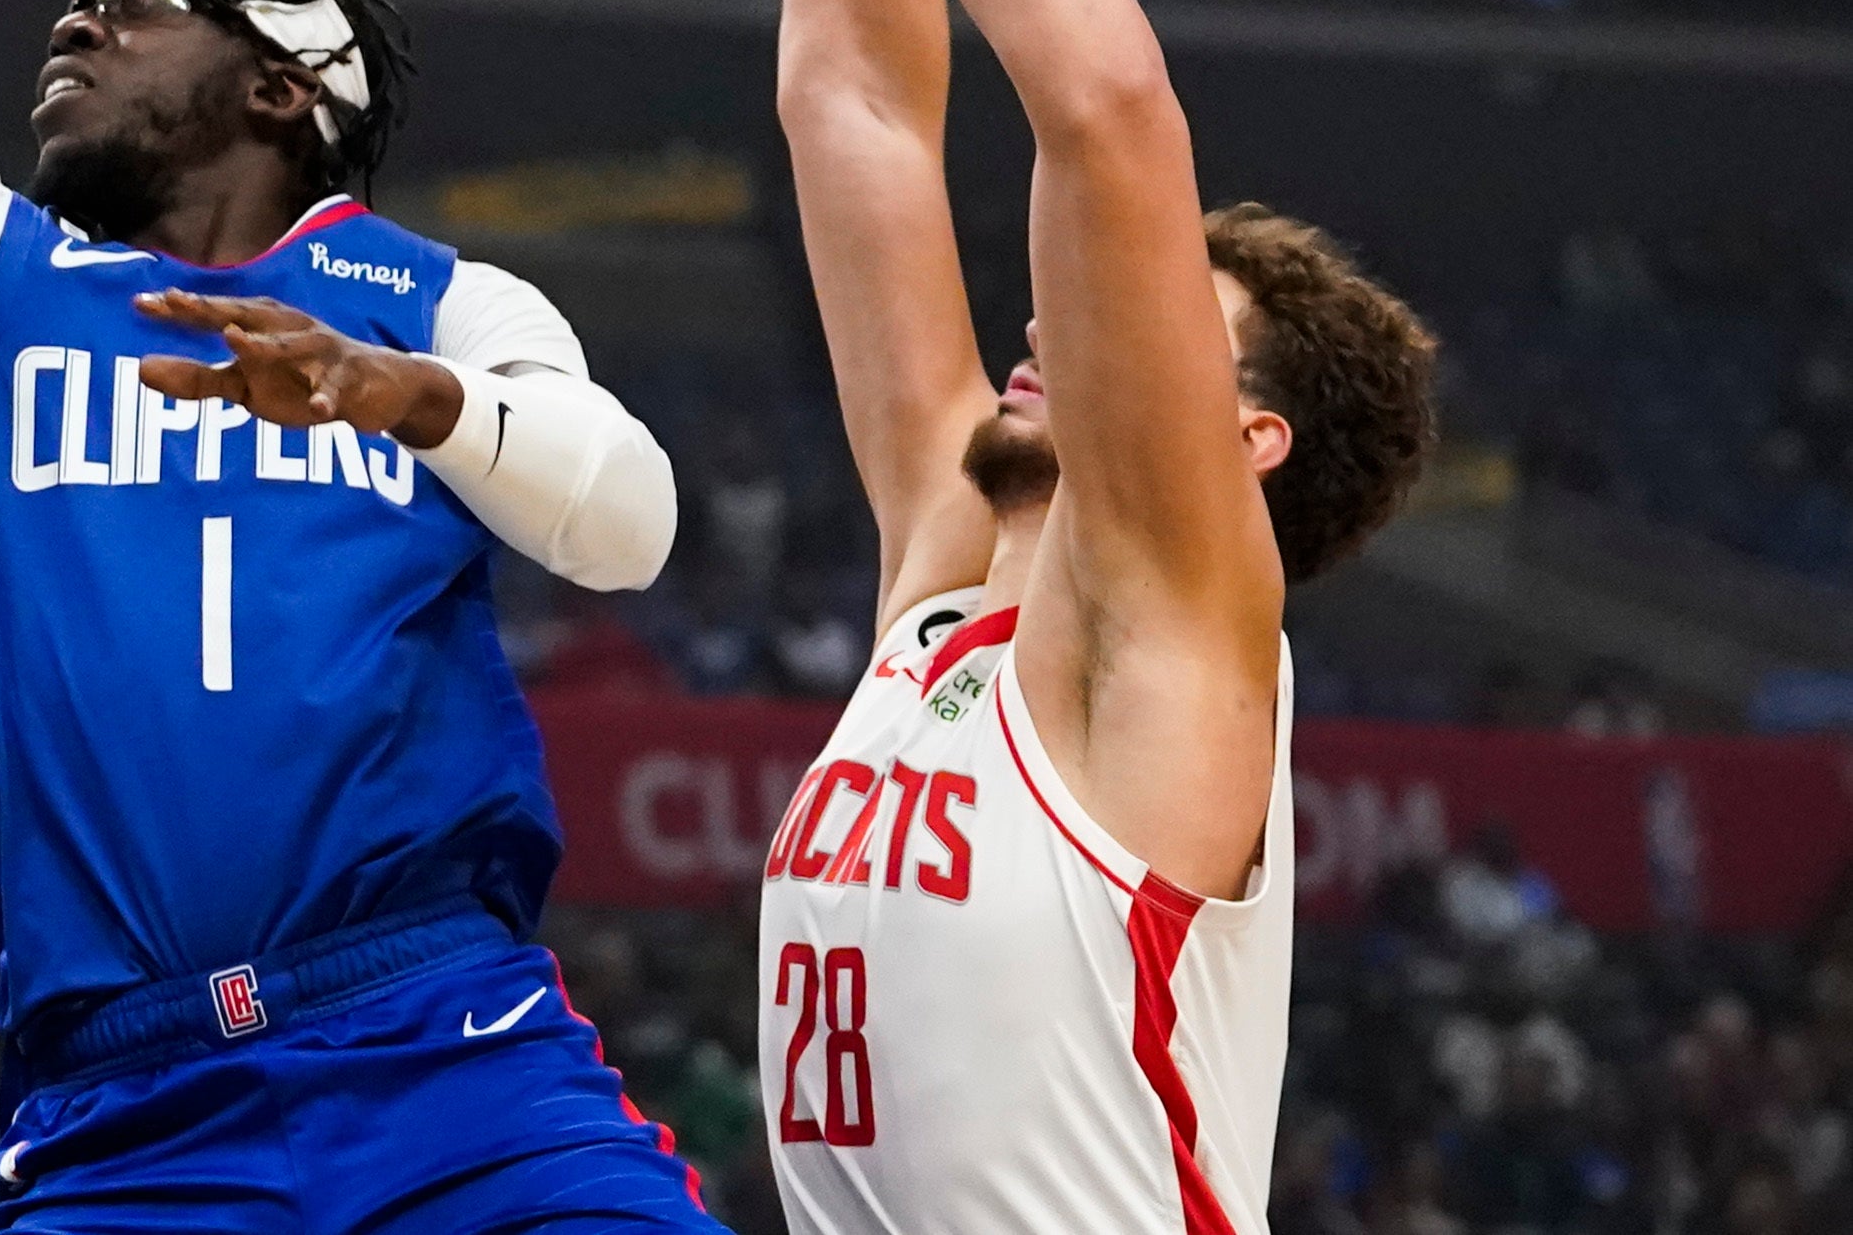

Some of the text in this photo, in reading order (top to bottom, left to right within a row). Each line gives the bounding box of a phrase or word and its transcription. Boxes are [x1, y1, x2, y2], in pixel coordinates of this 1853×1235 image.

[308, 242, 417, 295] honey
[202, 516, 234, 692] 1
[774, 941, 876, 1148] 28
